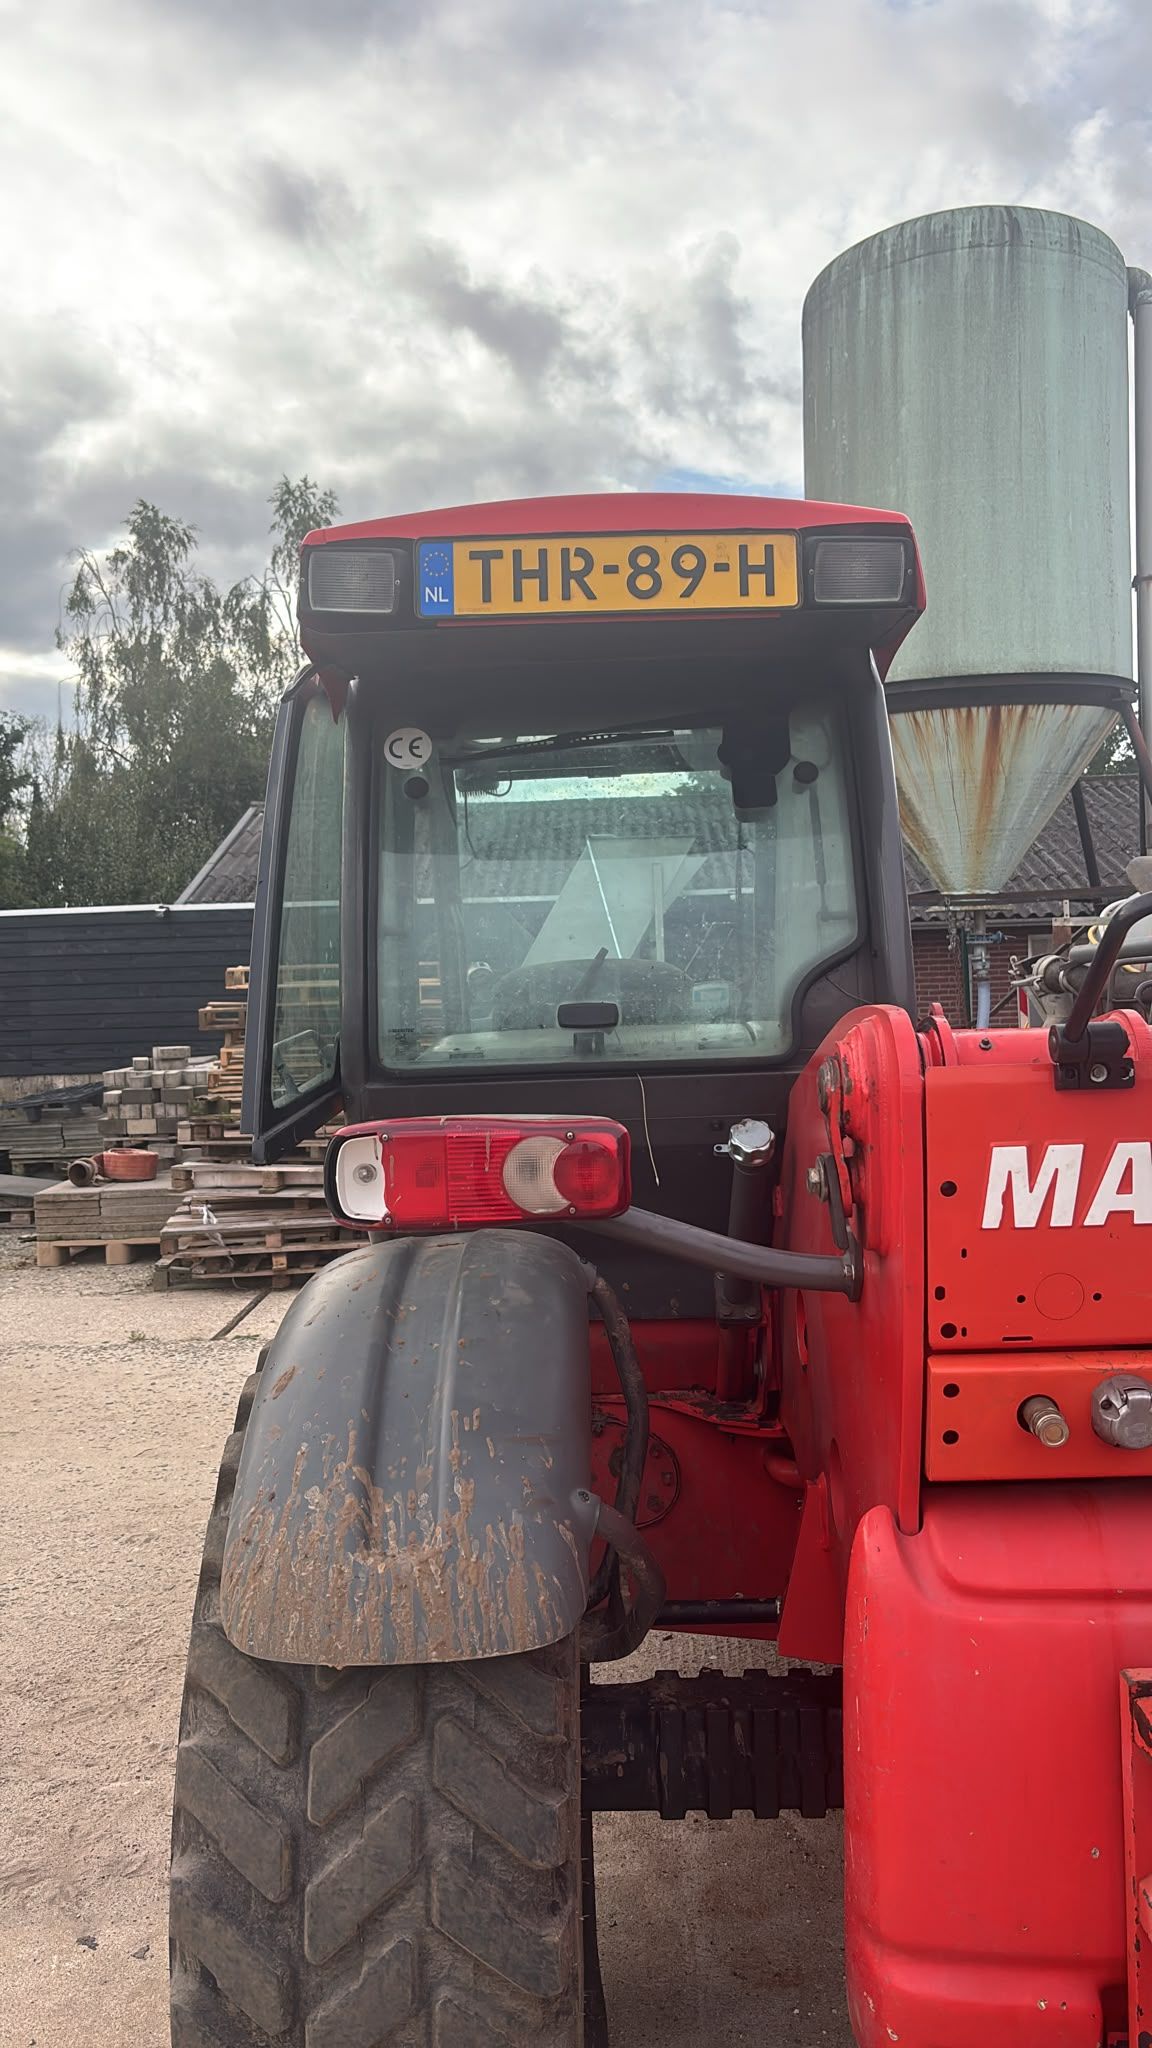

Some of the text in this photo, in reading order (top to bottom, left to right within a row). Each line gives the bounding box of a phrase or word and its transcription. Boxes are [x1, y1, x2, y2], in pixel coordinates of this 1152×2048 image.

[468, 544, 776, 603] THR-89-H
[424, 586, 449, 603] NL
[388, 736, 423, 759] CE
[981, 1141, 1152, 1229] MA
